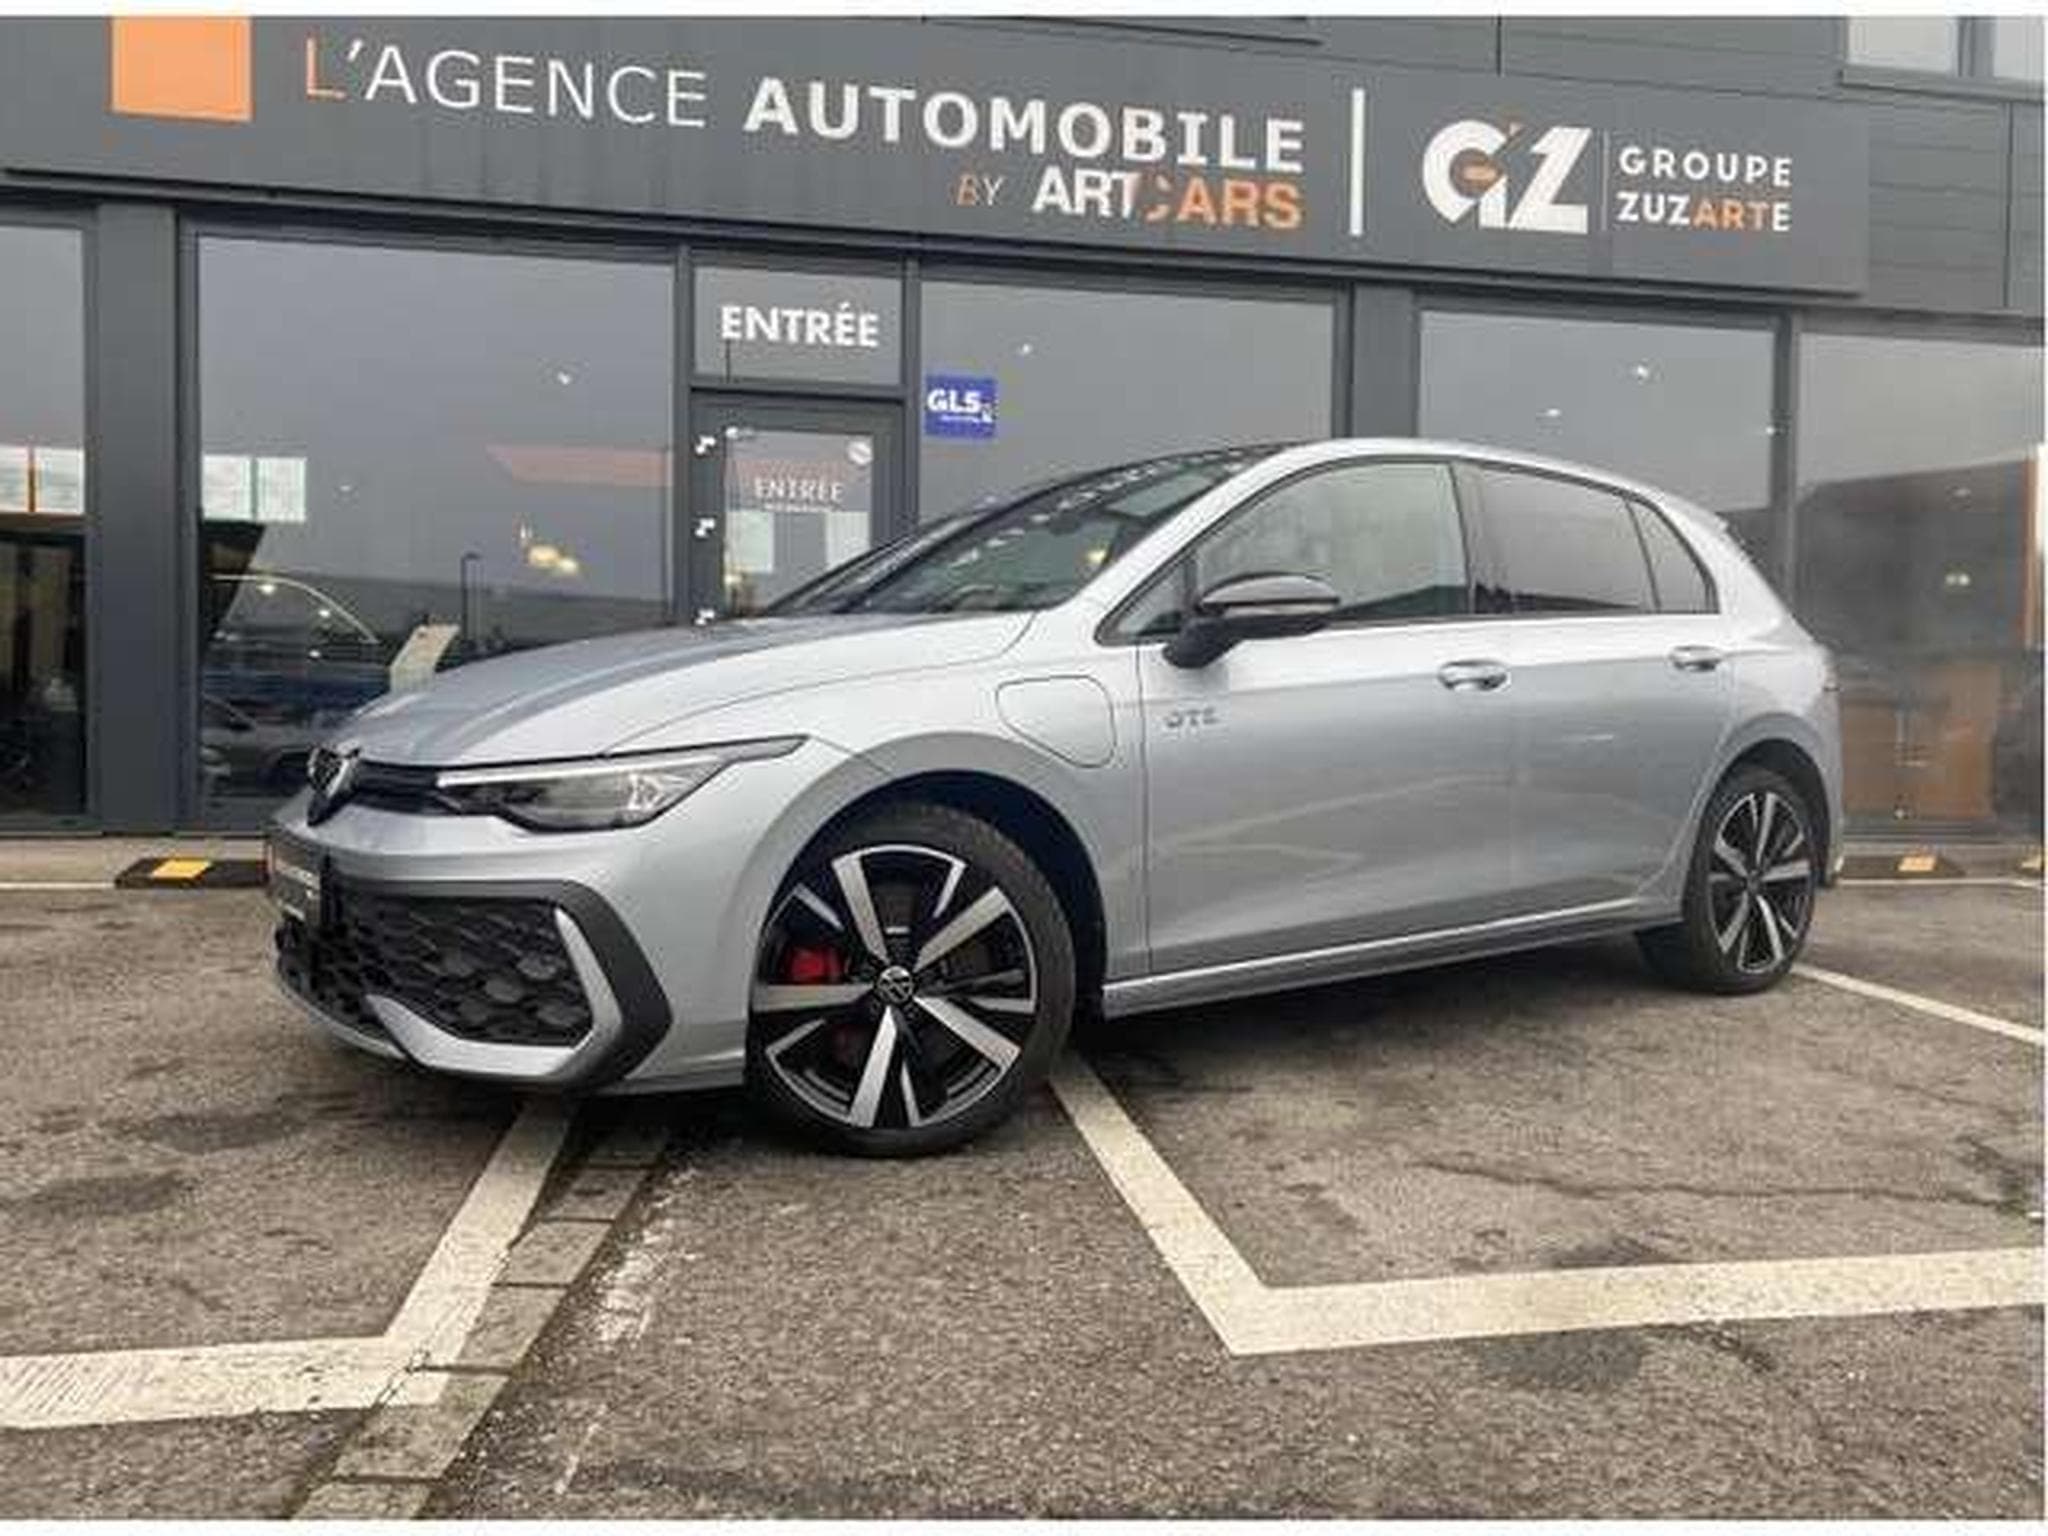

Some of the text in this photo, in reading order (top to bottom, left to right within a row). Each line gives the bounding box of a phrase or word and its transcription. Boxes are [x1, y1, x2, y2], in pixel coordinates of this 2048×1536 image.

[305, 37, 1304, 173] L'AGENCE AUTOMOBILE
[1619, 146, 1793, 188] GROUPE
[956, 173, 1002, 207] BY
[1616, 191, 1792, 232] ZUZARTE
[721, 301, 879, 347] ENTRÉE
[927, 388, 981, 412] GLS
